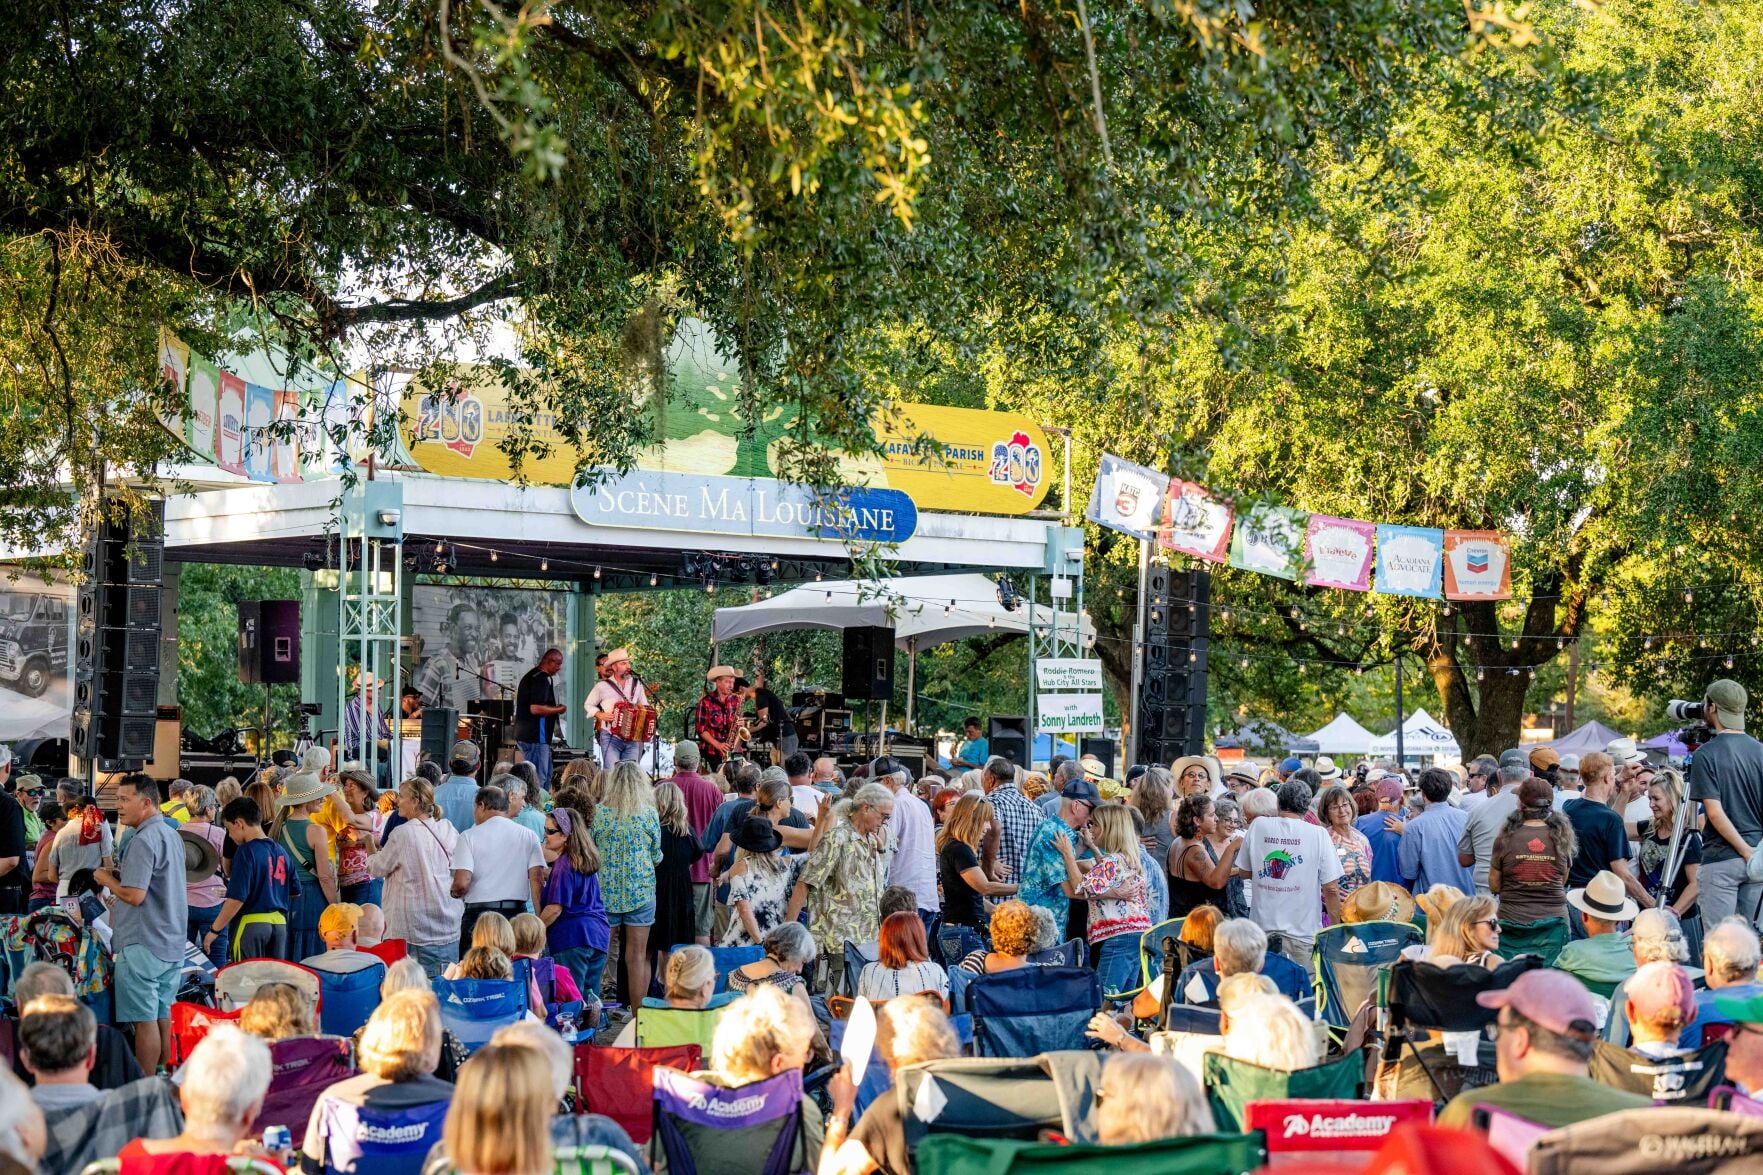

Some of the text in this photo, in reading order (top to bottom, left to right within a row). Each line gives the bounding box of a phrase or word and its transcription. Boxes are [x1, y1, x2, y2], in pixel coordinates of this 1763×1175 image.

[945, 448, 985, 462] PARISH
[993, 443, 1040, 485] 200
[1043, 667, 1095, 675] Roddie Romero
[1056, 679, 1069, 687] City
[1041, 712, 1101, 729] Sonny Landreth
[1280, 838, 1302, 846] FAMOUS
[267, 855, 287, 887] 14
[707, 1093, 767, 1114] Academy
[356, 1120, 429, 1140] Academy
[1310, 1112, 1396, 1134] Academy
